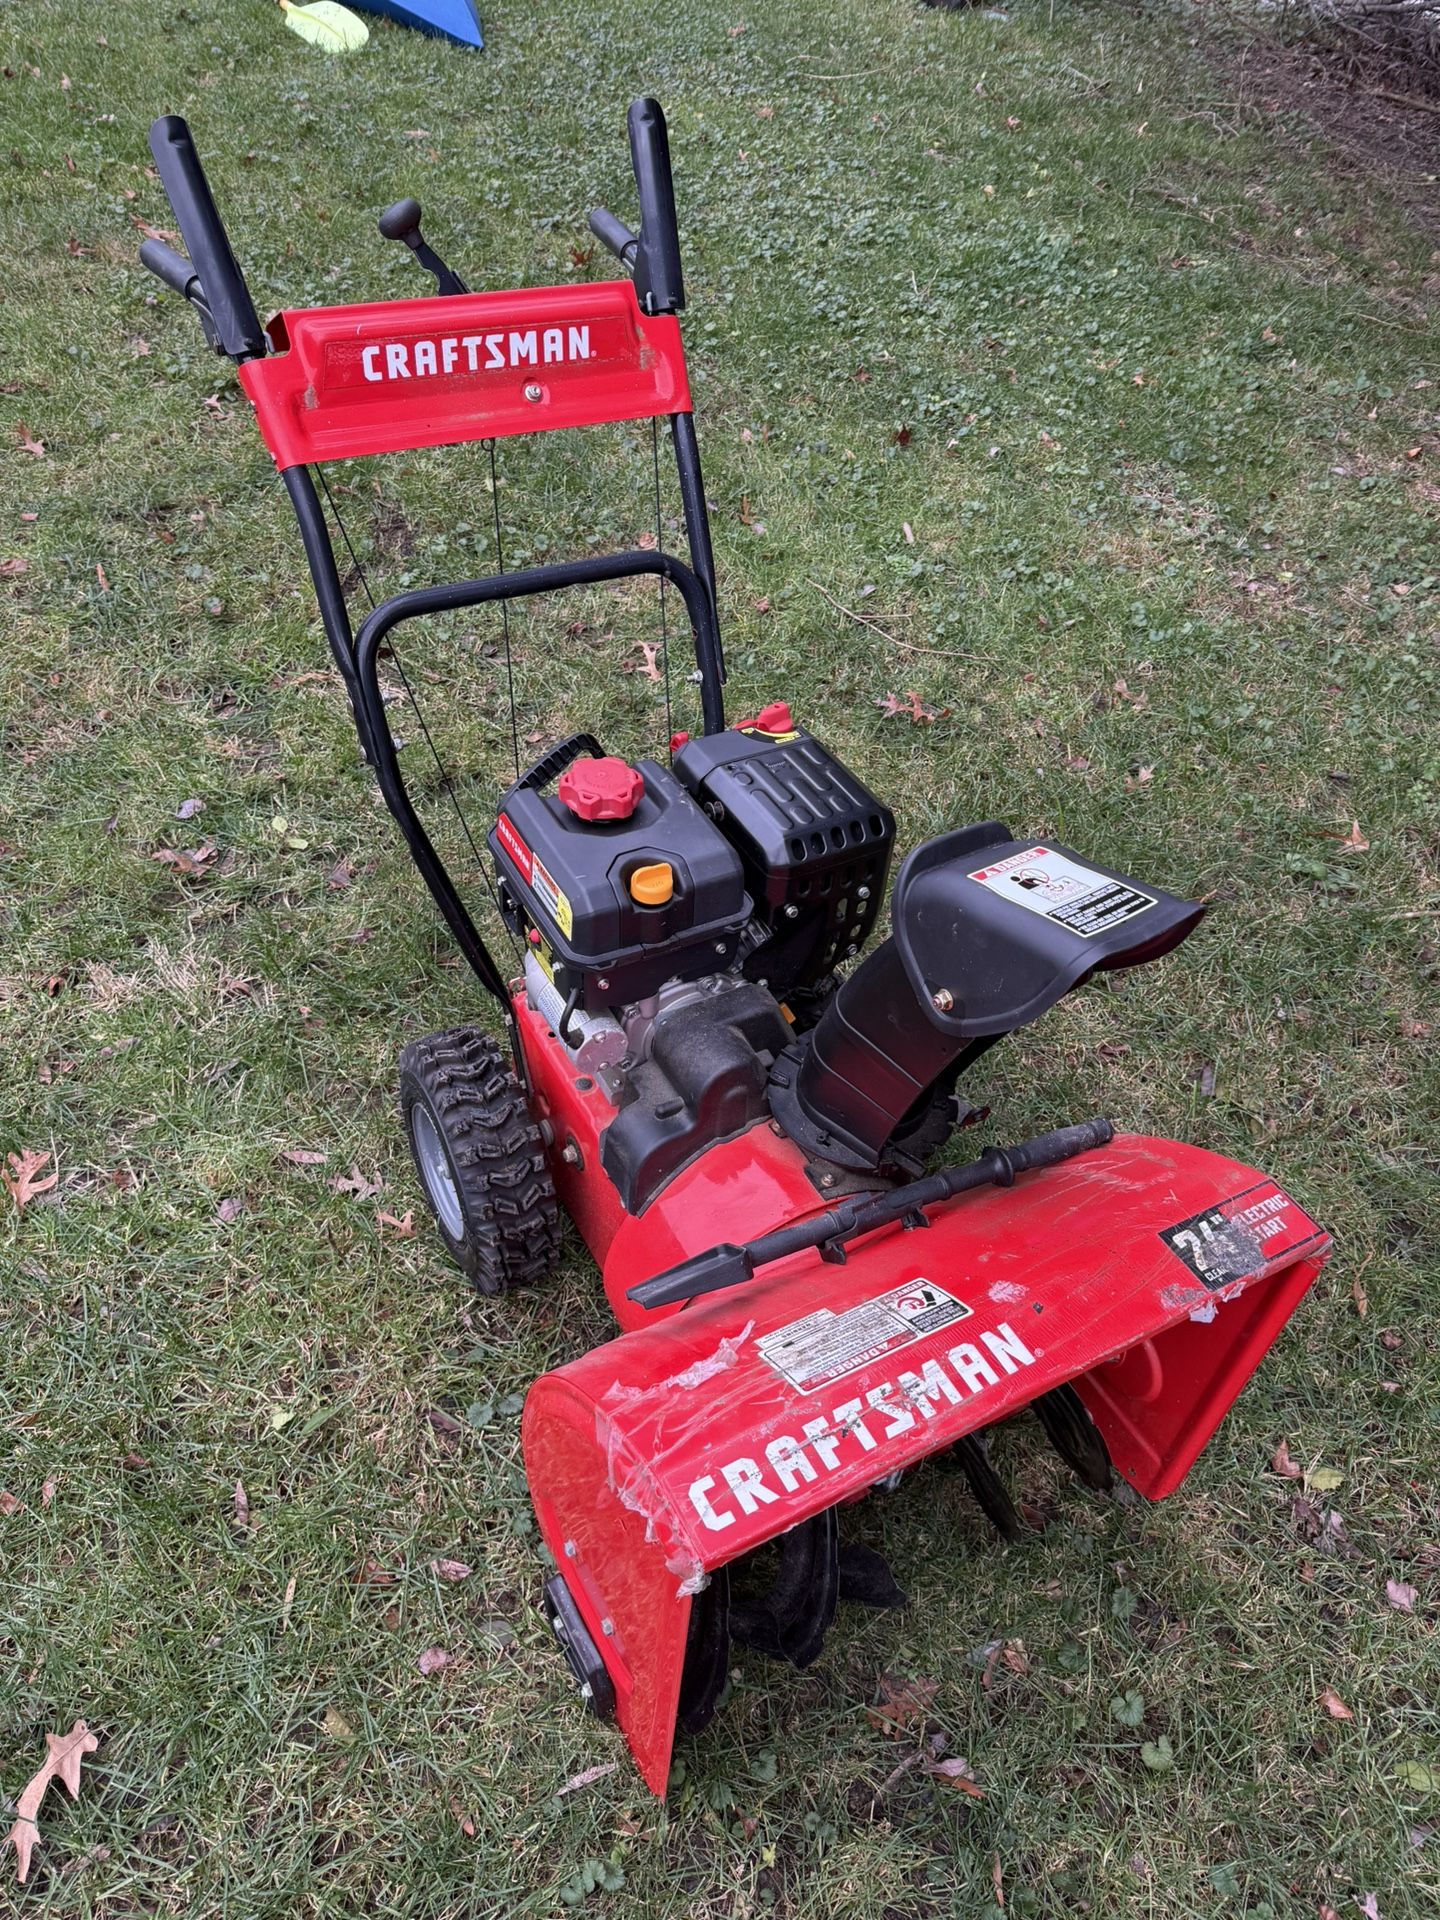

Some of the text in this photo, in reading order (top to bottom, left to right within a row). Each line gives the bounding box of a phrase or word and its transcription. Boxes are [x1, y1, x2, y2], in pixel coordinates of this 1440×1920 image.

[362, 326, 590, 381] CRAFTSMAN
[995, 850, 1044, 873] DANGER
[891, 1281, 926, 1298] DANGER
[824, 1347, 881, 1378] DANGER
[688, 1322, 1036, 1532] CRAFTSMAN
